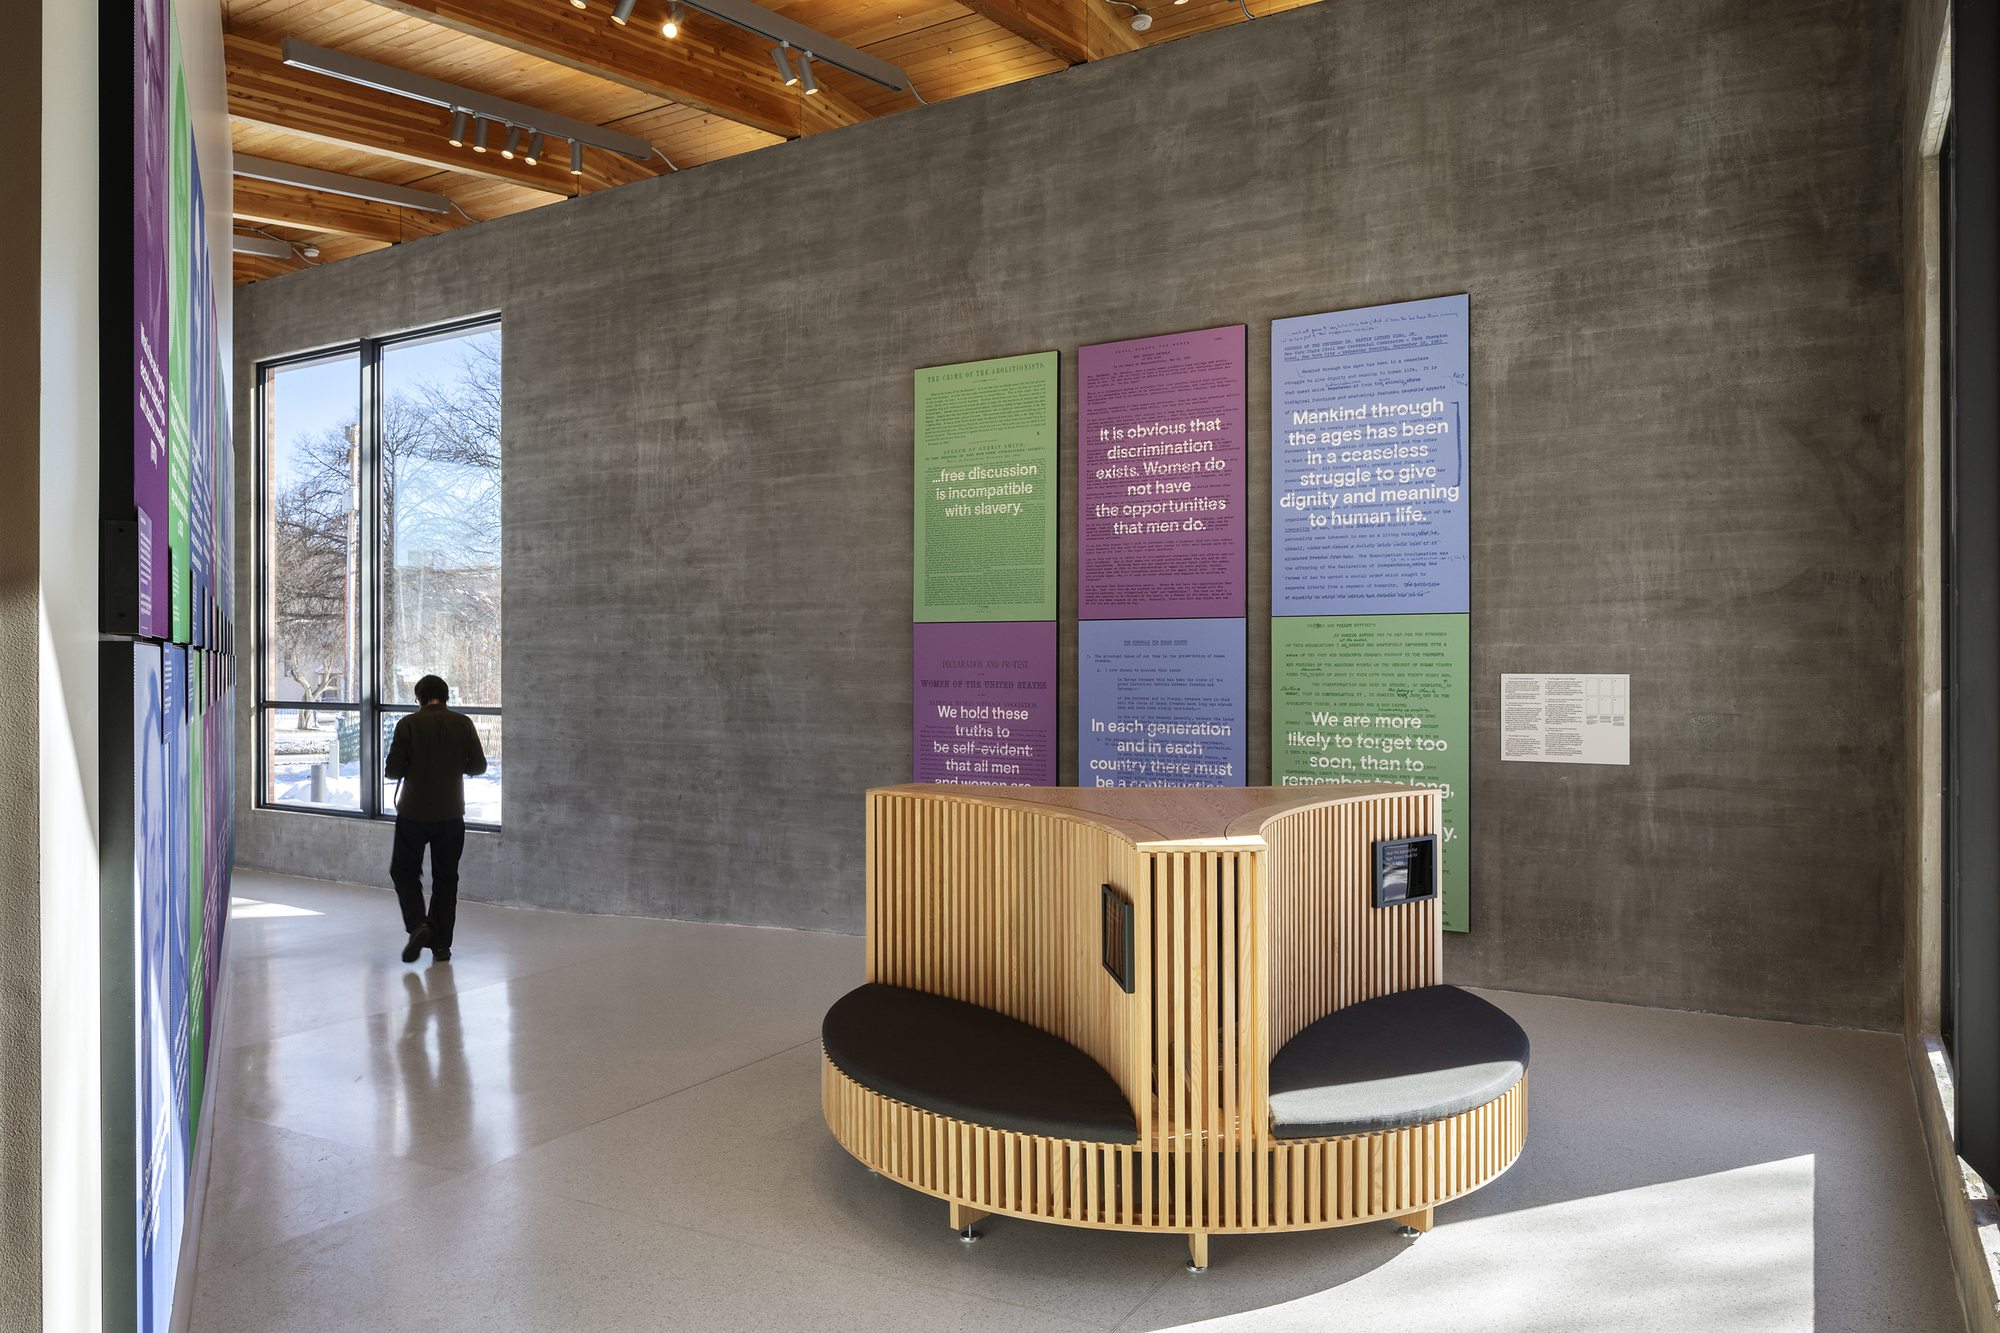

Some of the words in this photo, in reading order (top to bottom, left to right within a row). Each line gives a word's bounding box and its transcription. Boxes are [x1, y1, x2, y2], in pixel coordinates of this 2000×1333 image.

[1294, 405, 1366, 425] Mankind
[1371, 398, 1443, 418] through
[1101, 428, 1109, 441] It
[1113, 427, 1123, 439] is
[1128, 423, 1186, 438] obvious
[1190, 418, 1221, 432] that
[1289, 432, 1316, 445] the
[1321, 430, 1361, 446] ages
[1367, 425, 1397, 439] has
[1403, 422, 1448, 436] been
[1108, 439, 1214, 459] discrimination
[1308, 451, 1321, 464] in
[1327, 453, 1336, 463] a
[1342, 444, 1428, 462] ceaseless
[933, 469, 965, 482] ...free
[968, 464, 1036, 479] discussion
[1096, 465, 1139, 479] exists.
[1143, 461, 1200, 475] Women
[1205, 457, 1225, 470] do
[1301, 468, 1371, 487] struggle
[1376, 468, 1394, 480] to
[1399, 464, 1436, 483] give
[937, 488, 945, 500] is
[949, 482, 1032, 499] incompatible
[1128, 484, 1151, 495] not
[1156, 481, 1191, 493] have
[1280, 491, 1339, 510] dignity
[1343, 488, 1375, 504] and
[1381, 484, 1458, 501] meaning
[945, 504, 970, 516] with
[975, 503, 1022, 516] slavery.
[1096, 504, 1118, 517] the
[1123, 497, 1226, 517] opportunities
[1309, 514, 1327, 526] to
[1332, 509, 1390, 525] human
[1396, 506, 1426, 522] life.
[1114, 522, 1143, 534] that
[1147, 522, 1178, 532] men
[1183, 518, 1206, 531] do.
[942, 660, 983, 669] DECLARATION
[987, 660, 999, 669] AND
[1001, 661, 1028, 669] PROTEST
[921, 679, 950, 688] WOMEN
[952, 680, 963, 688] OF
[965, 680, 981, 688] THE
[984, 681, 1014, 689] UNITED
[1017, 681, 1047, 690] STATES
[938, 706, 957, 718] We
[961, 706, 988, 718] hold
[992, 707, 1028, 720] these
[1312, 712, 1338, 726] We
[1343, 716, 1370, 727] are
[1376, 717, 1421, 728] more
[956, 724, 993, 737] truths
[997, 726, 1009, 737] to
[1092, 719, 1104, 731] In
[1108, 720, 1143, 732] each
[1148, 722, 1230, 737] generation
[934, 741, 949, 753] be
[953, 741, 1033, 757] self-evident:
[1117, 741, 1144, 752] and
[1149, 741, 1161, 753] in
[1166, 743, 1202, 754] each
[1289, 732, 1330, 750] likely
[1335, 734, 1352, 747] to
[1357, 734, 1411, 753] forget
[1416, 737, 1447, 751] too
[946, 759, 970, 771] that
[974, 760, 987, 772] all
[992, 764, 1019, 774] men
[1090, 759, 1146, 773] country
[1151, 761, 1190, 773] there
[1195, 764, 1232, 776] must
[1310, 757, 1355, 771] soon,
[1360, 755, 1400, 770] than
[1405, 758, 1423, 771] to
[1097, 775, 1113, 787] be
